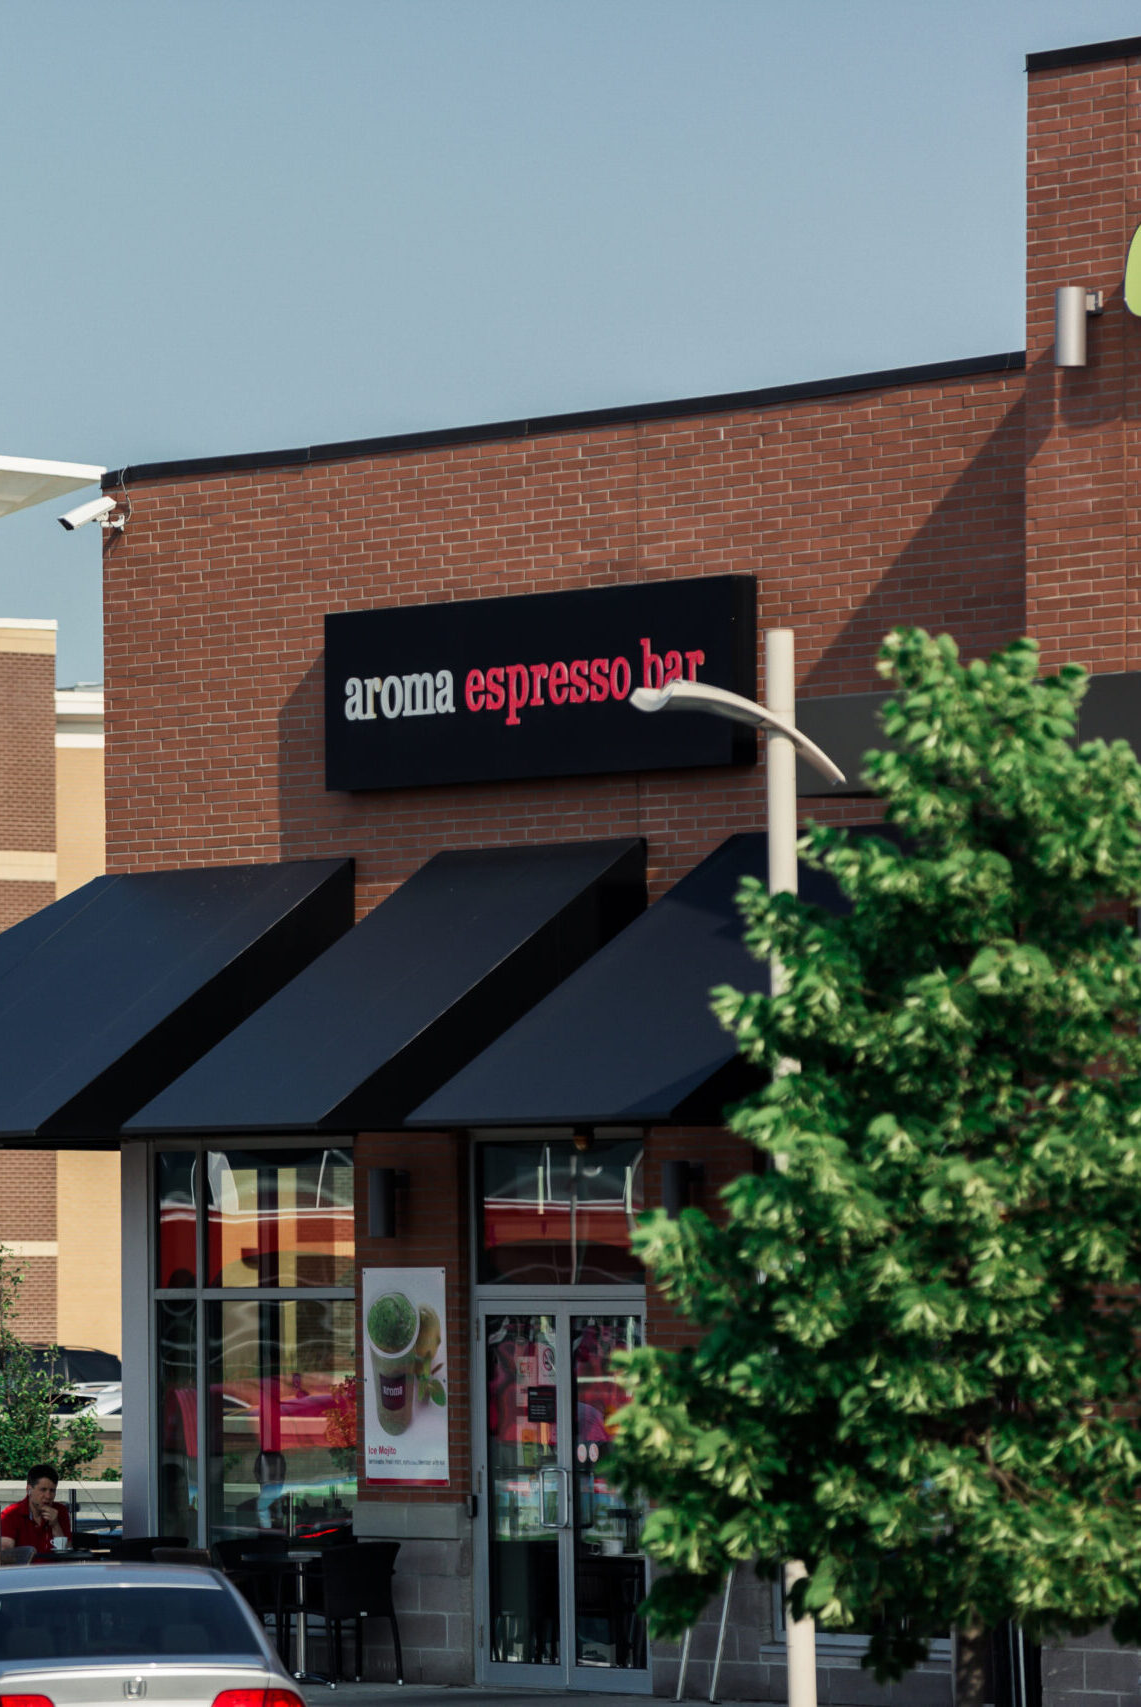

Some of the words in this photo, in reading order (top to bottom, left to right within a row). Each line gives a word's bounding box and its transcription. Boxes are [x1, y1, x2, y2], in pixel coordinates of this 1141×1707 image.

[344, 668, 456, 721] aroma
[465, 656, 632, 726] espresso
[639, 637, 706, 690] bar
